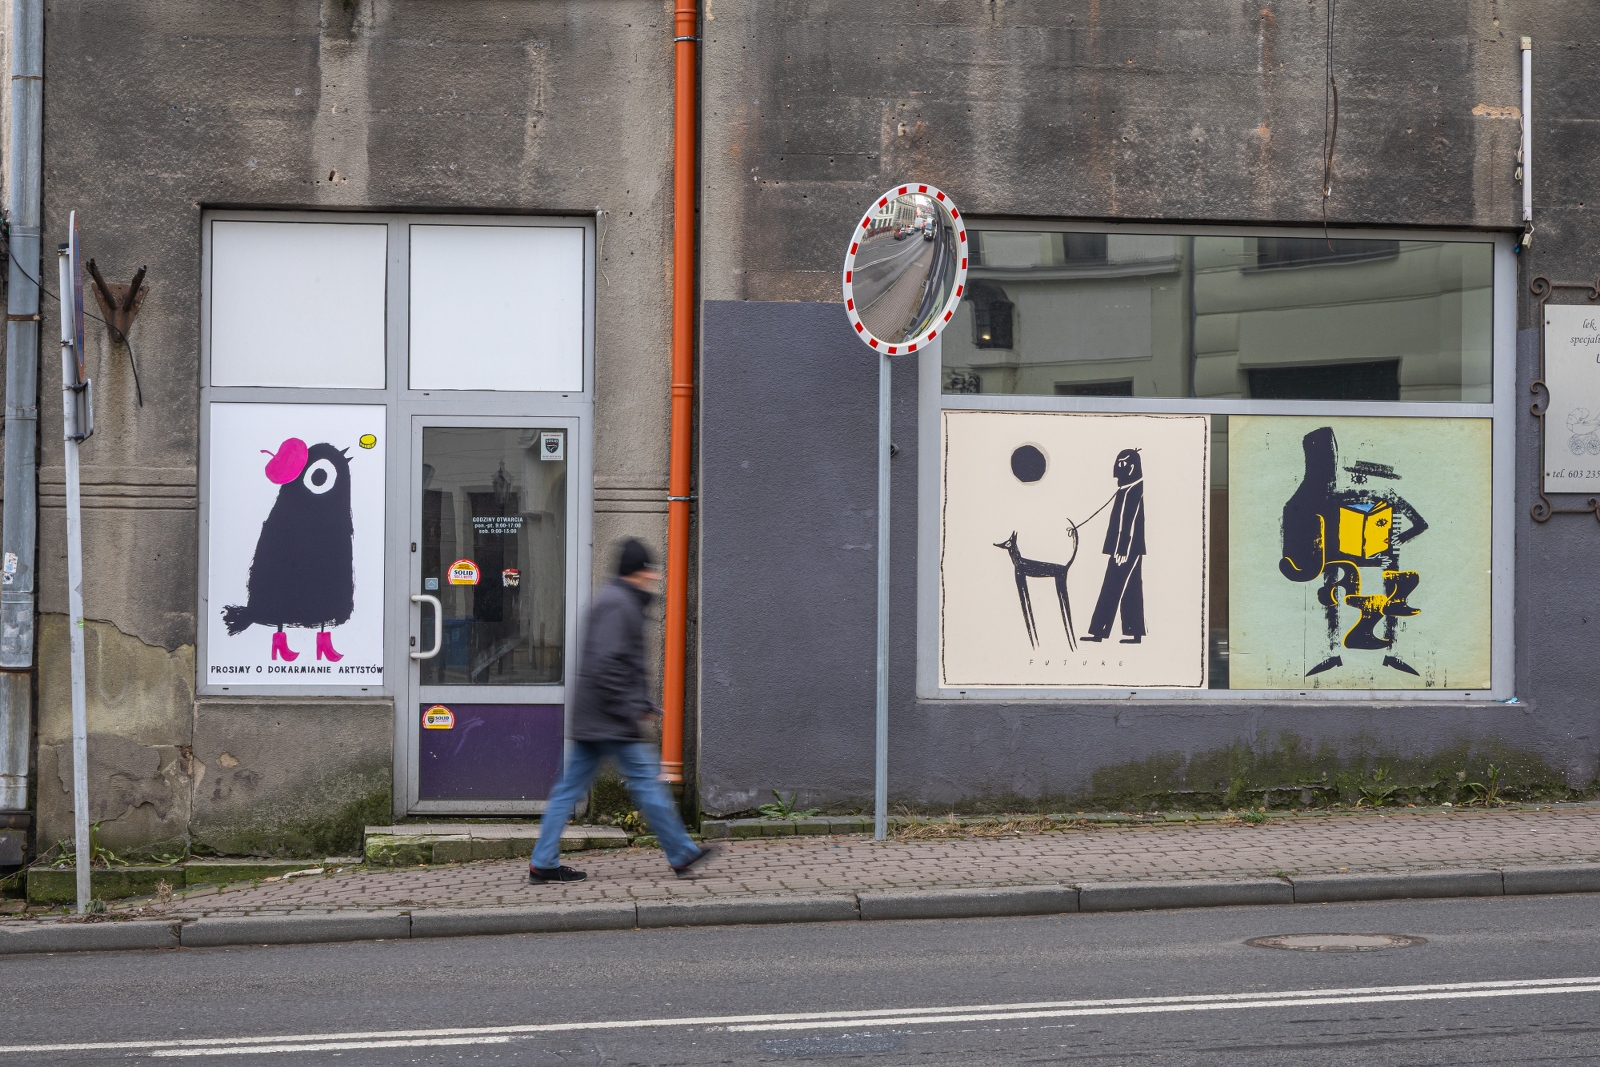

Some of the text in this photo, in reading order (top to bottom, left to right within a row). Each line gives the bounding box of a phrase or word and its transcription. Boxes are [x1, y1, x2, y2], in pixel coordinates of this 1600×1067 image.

[1552, 468, 1565, 478] tel.
[1568, 469, 1583, 478] 603
[210, 664, 384, 674] PROSIMY O DOKARMIANIE ARTYSTÓW
